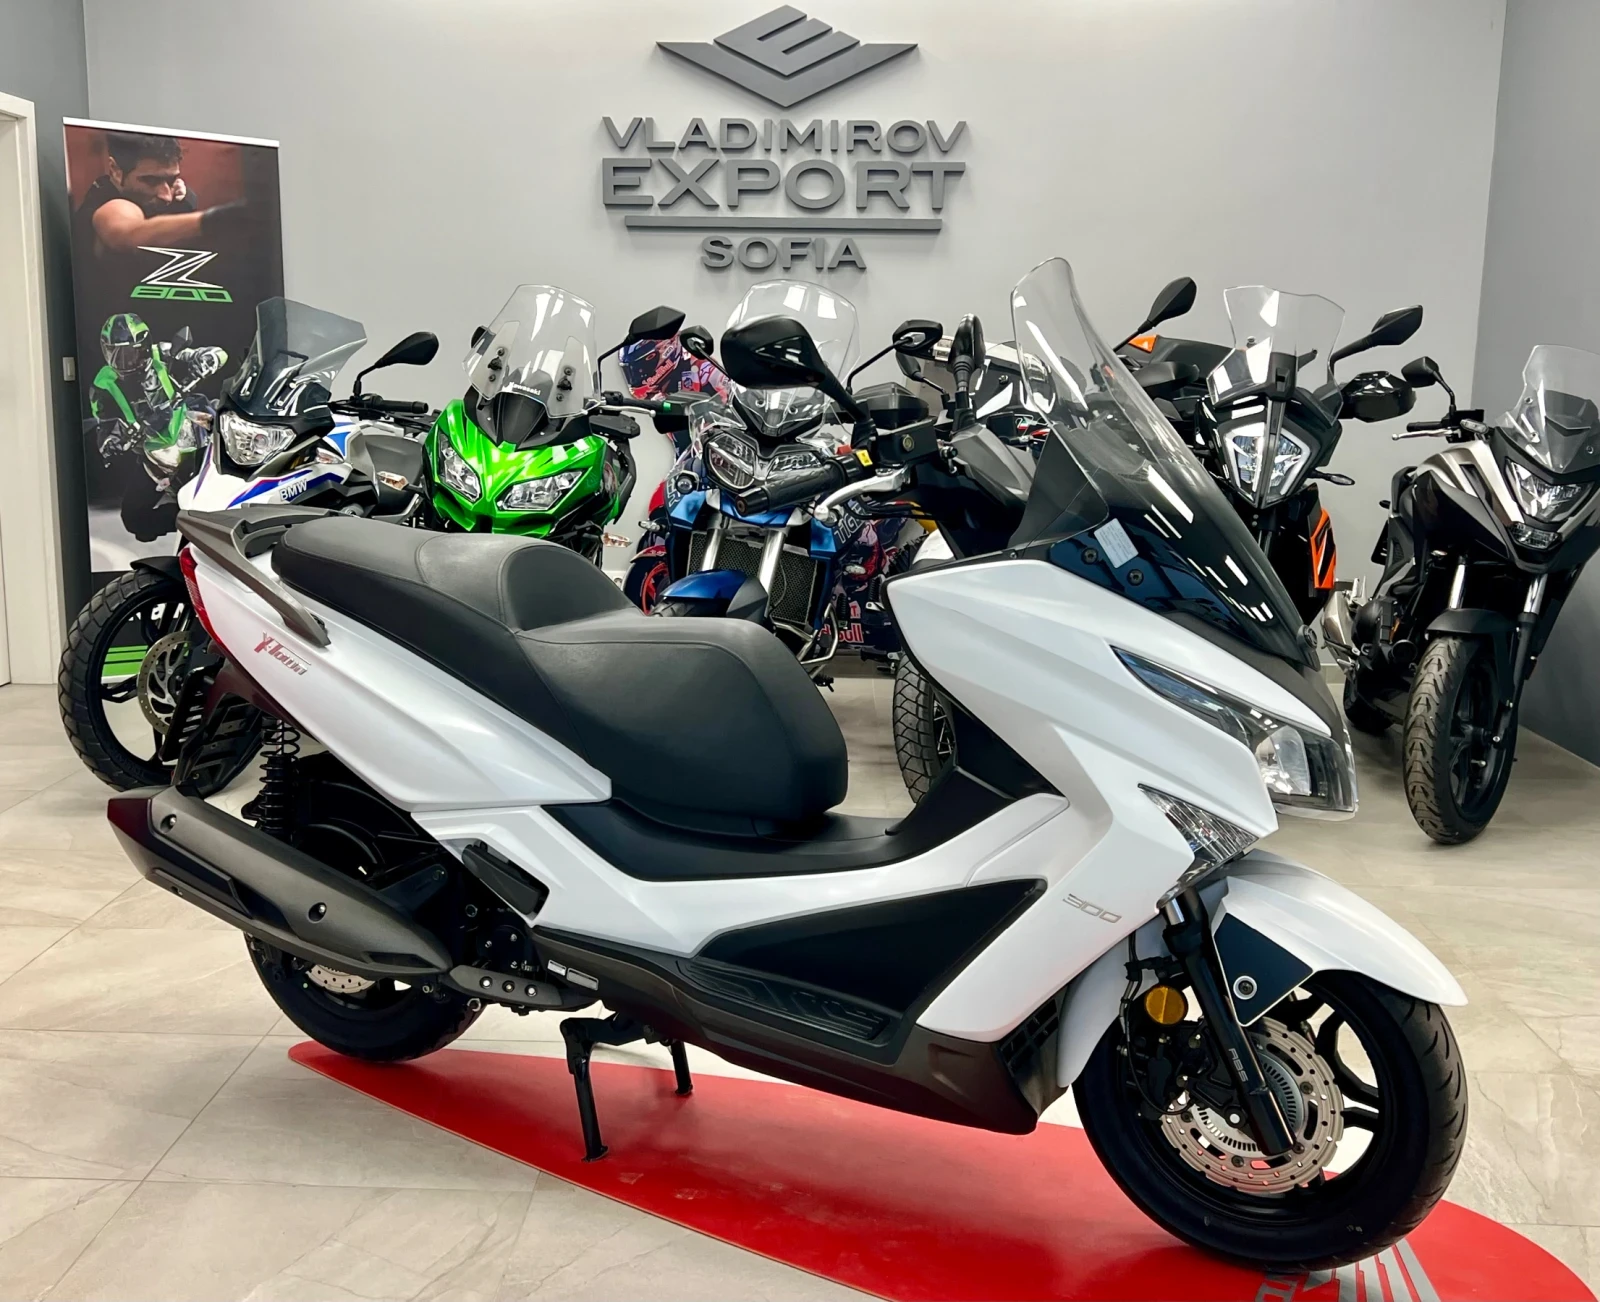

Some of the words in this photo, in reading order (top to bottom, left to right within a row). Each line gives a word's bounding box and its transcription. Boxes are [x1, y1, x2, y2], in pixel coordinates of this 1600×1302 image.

[602, 116, 967, 153] VLADIMIROV
[602, 157, 966, 211] EXPORT
[701, 235, 867, 270] SOFIA
[130, 285, 234, 303] 800
[280, 479, 308, 502] BMW
[1062, 893, 1122, 924] 300
[1229, 1047, 1249, 1082] ABS
